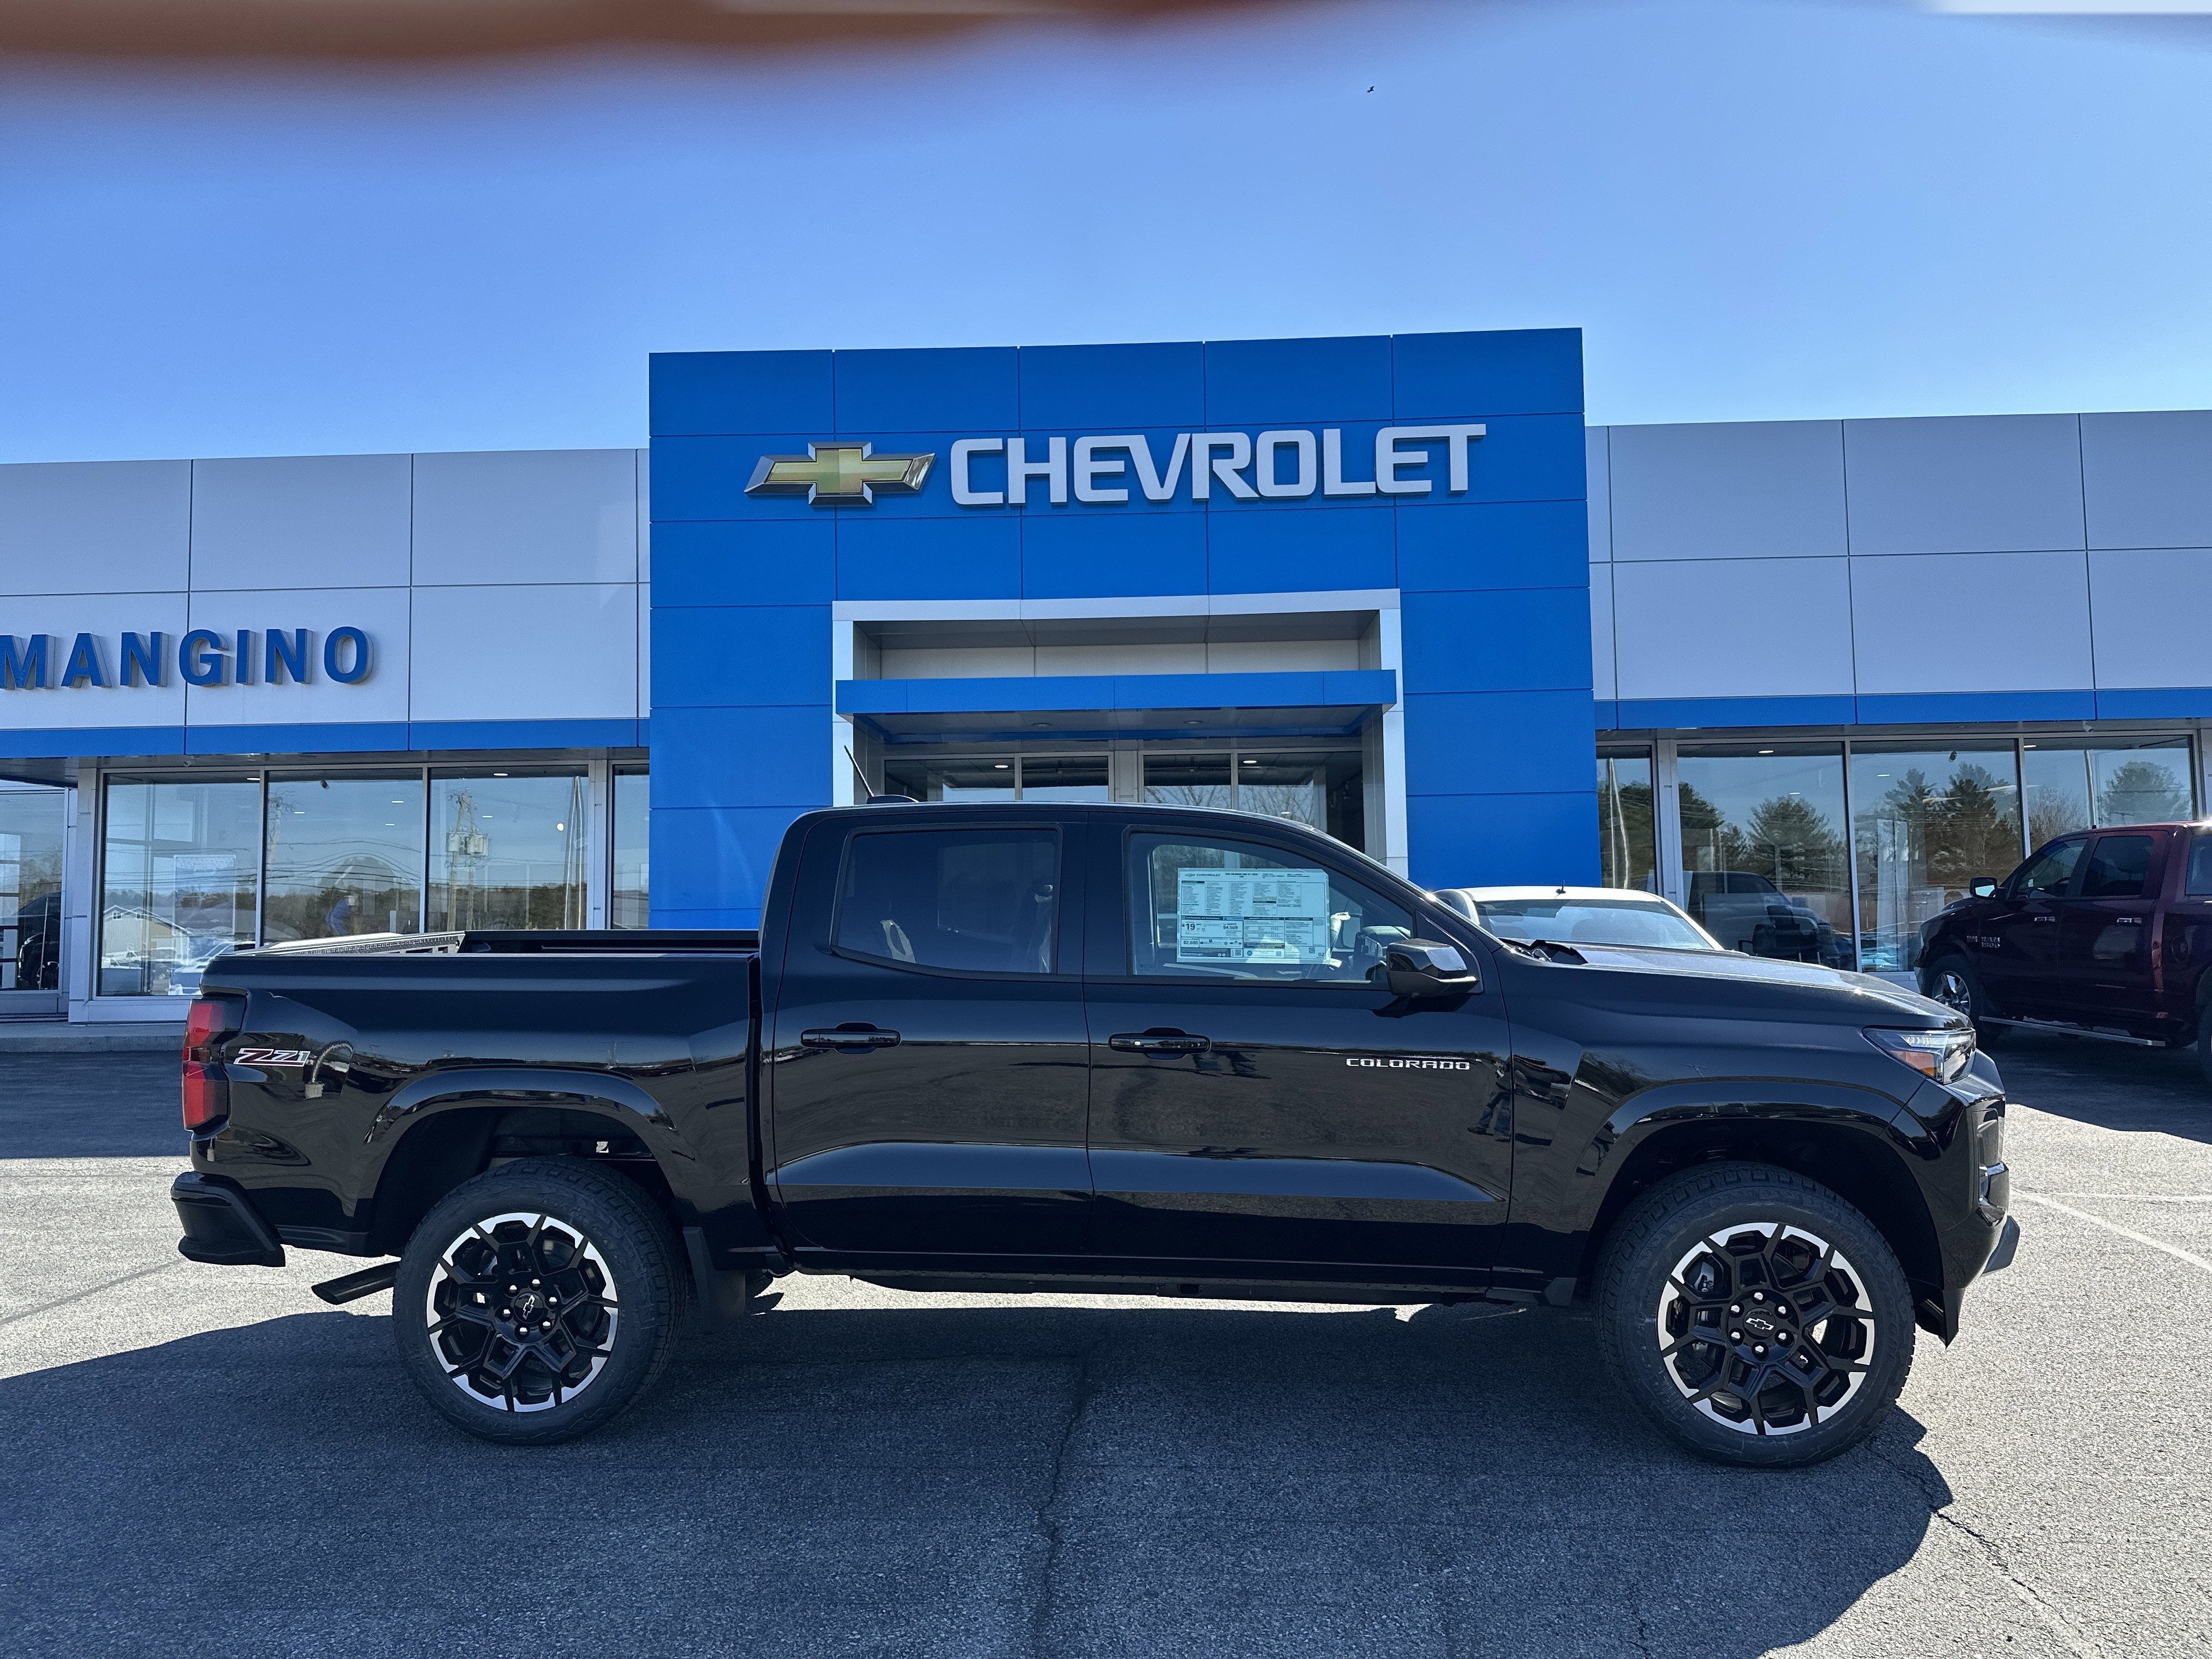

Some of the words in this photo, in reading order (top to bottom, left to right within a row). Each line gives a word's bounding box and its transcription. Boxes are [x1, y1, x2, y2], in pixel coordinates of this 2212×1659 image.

[950, 423, 1486, 506] CHEVROLET
[0, 626, 375, 690] MANGINO
[233, 1047, 311, 1068] Z71
[1346, 1058, 1470, 1070] COLORADO
